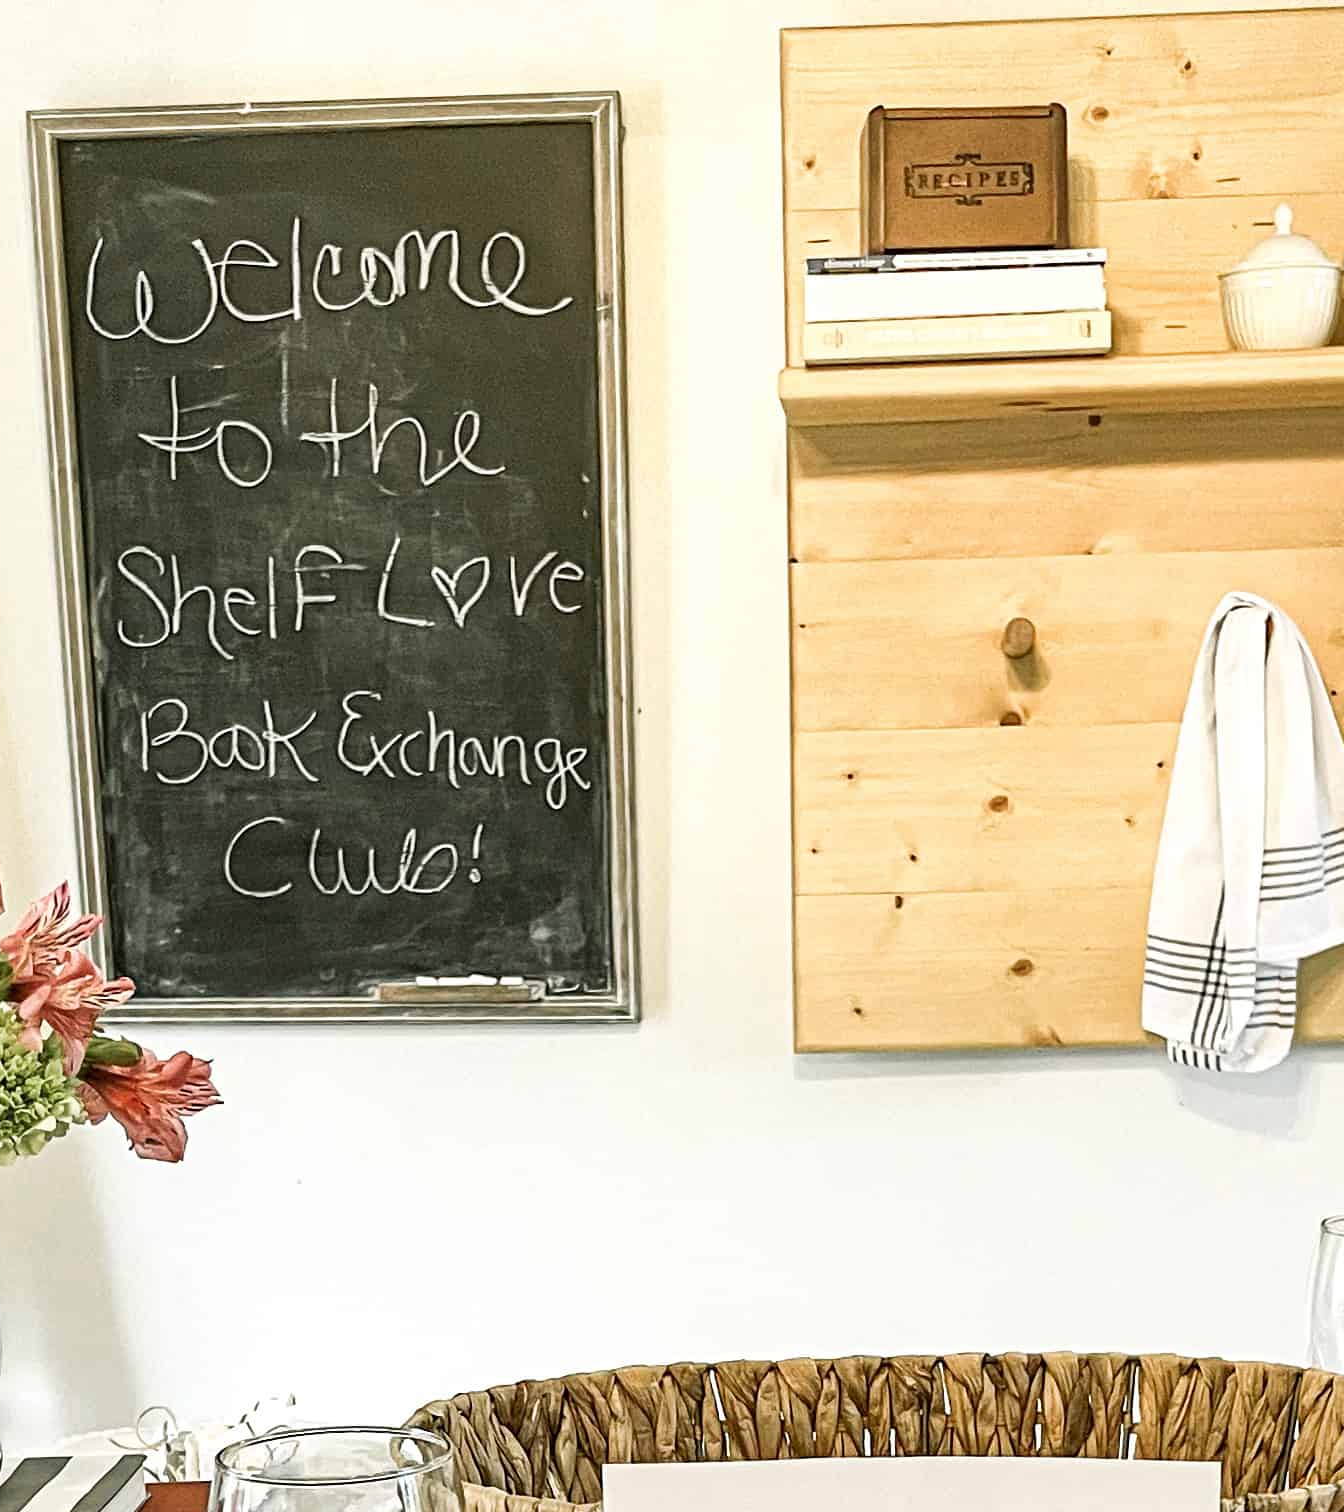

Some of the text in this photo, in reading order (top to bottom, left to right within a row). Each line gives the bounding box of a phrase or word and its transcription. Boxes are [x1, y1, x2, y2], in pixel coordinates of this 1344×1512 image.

[917, 170, 1020, 190] RECIPES
[85, 216, 573, 345] Welcome
[140, 376, 505, 488] to the
[140, 689, 592, 810] Book Exchange
